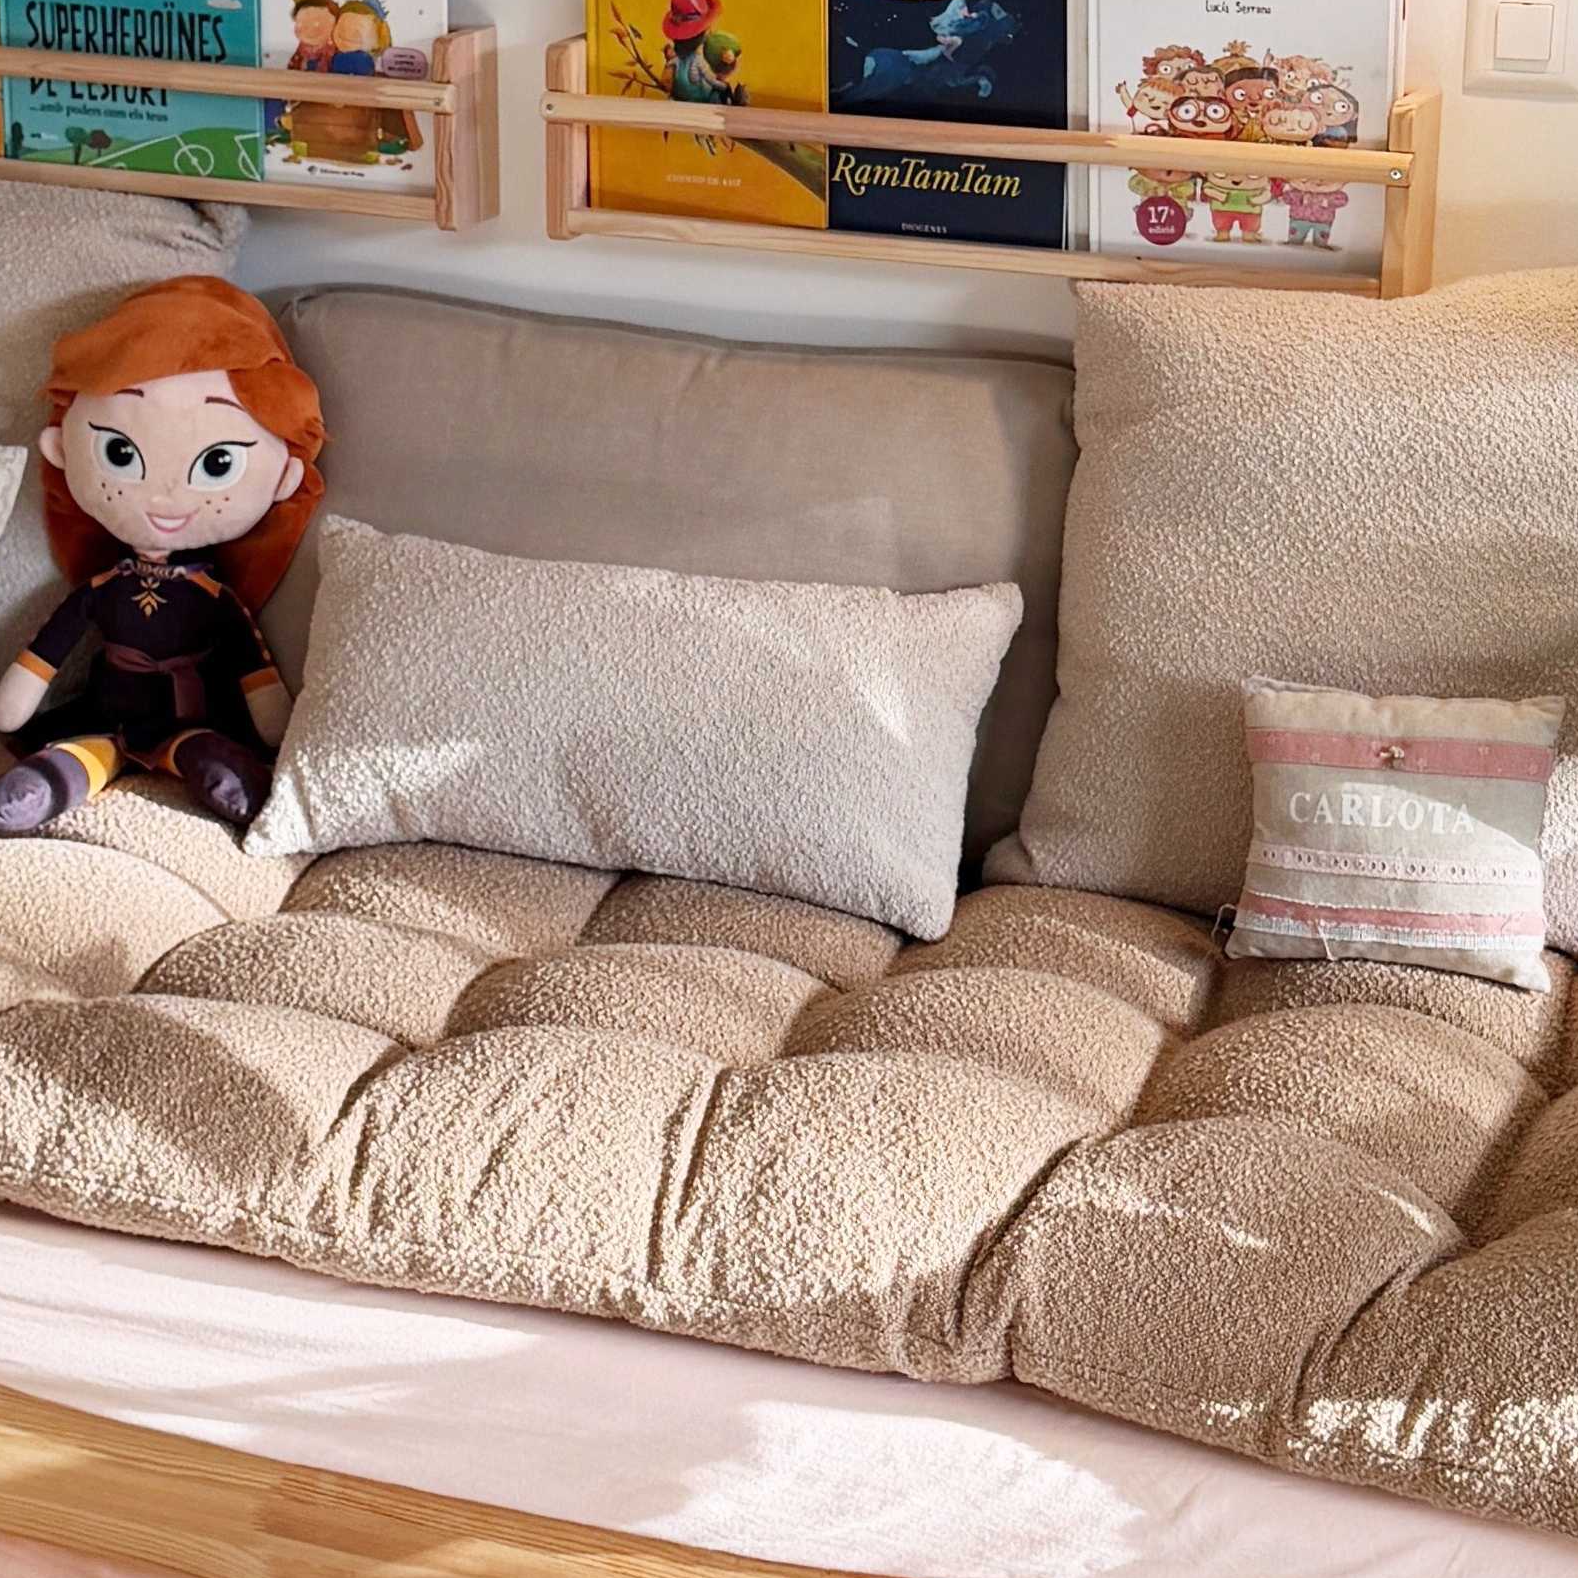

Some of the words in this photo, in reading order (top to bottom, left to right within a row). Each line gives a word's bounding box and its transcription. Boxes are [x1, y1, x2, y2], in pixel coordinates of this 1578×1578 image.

[26, 0, 227, 63] SUPERHEROÏNES
[66, 103, 101, 118] poders
[129, 107, 144, 120] els
[832, 152, 1022, 198] RamTamTam
[1288, 791, 1474, 835] CARLOTA
